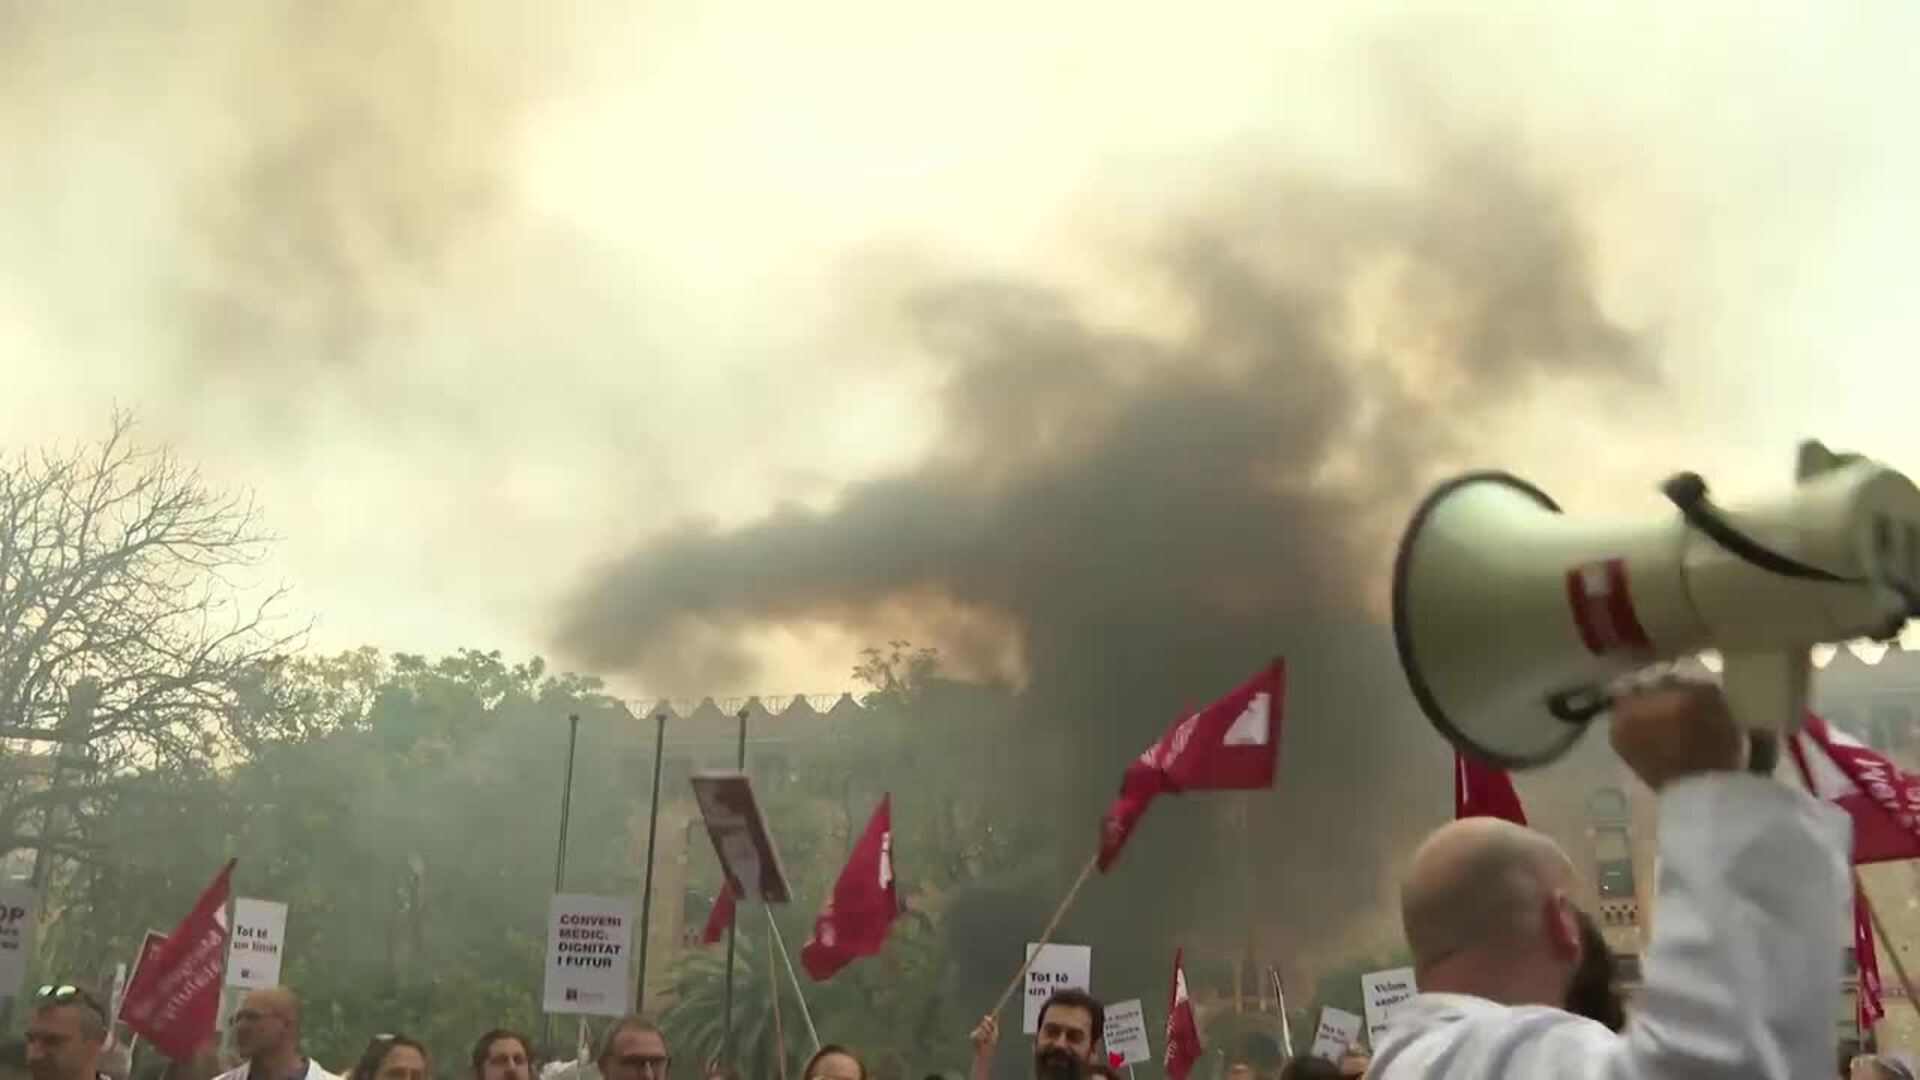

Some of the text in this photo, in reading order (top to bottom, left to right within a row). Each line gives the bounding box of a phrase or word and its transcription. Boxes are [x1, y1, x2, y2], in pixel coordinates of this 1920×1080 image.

[560, 914, 621, 928] CONVENI
[558, 941, 621, 955] DIGNITAT
[557, 955, 612, 969] I FUTUR
[1031, 971, 1051, 983] Tot
[1029, 986, 1046, 996] un
